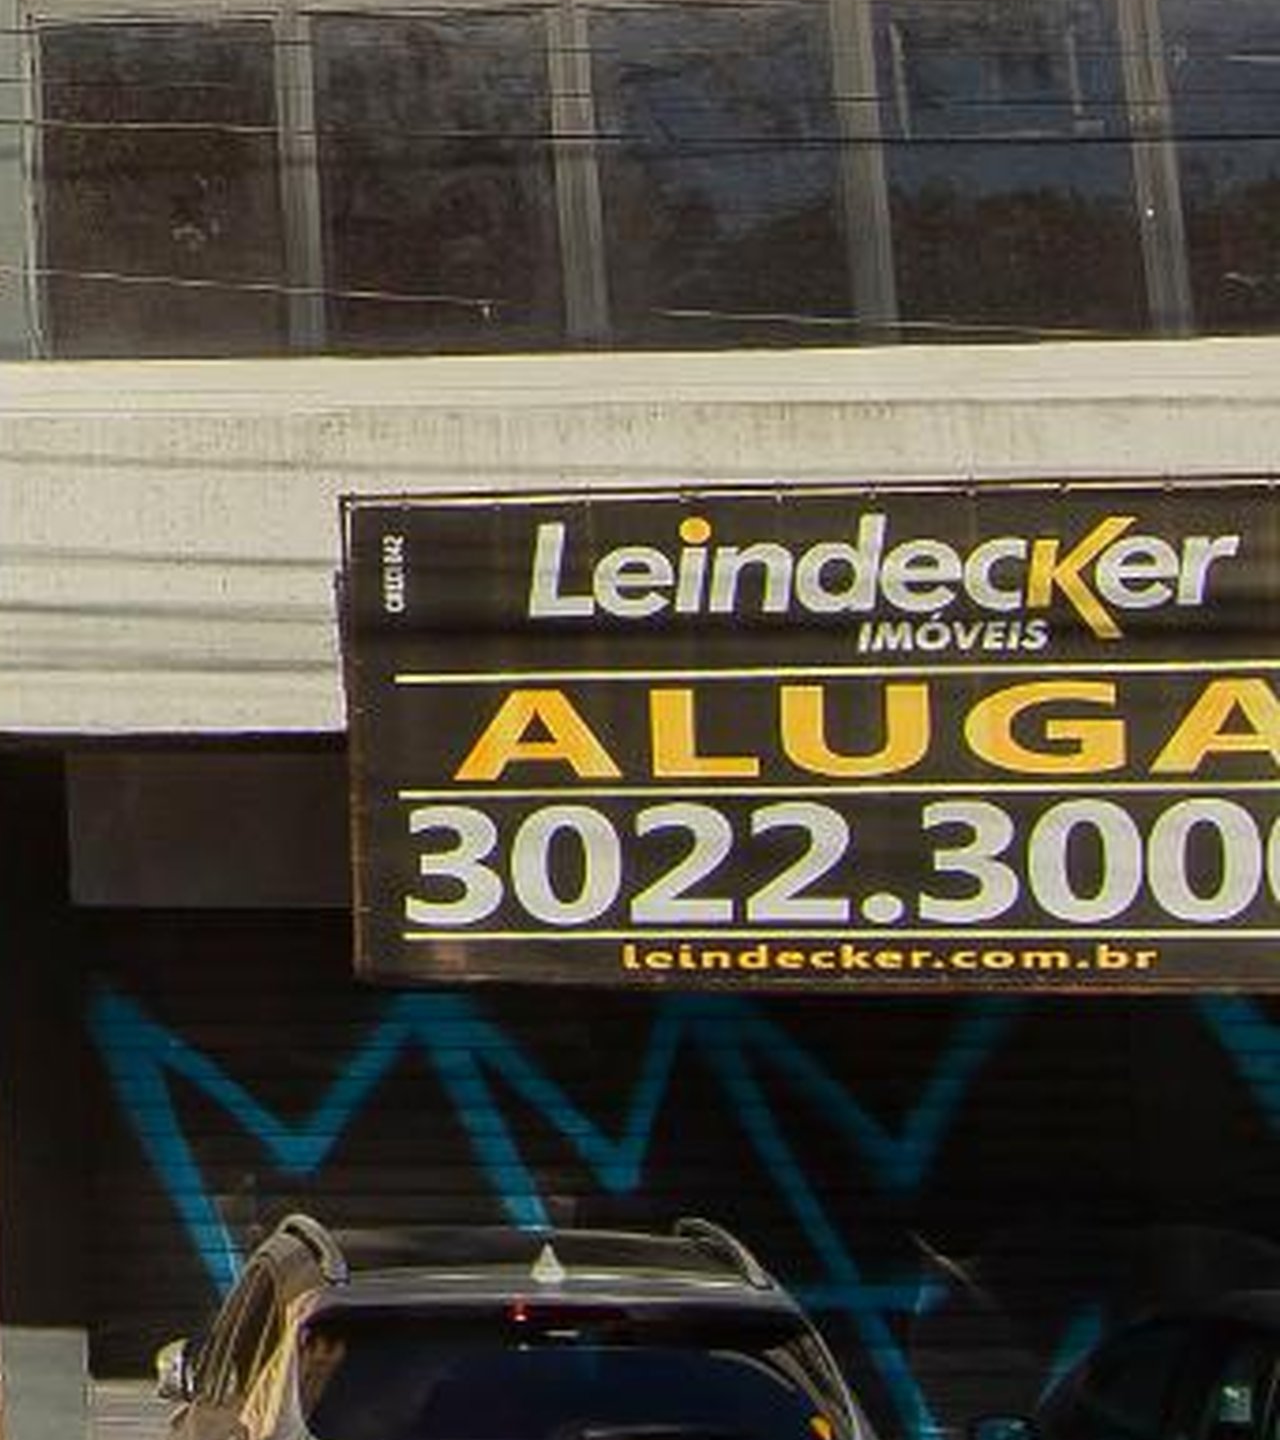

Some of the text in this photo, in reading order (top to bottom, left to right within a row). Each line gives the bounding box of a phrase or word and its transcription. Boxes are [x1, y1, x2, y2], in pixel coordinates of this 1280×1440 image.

[857, 615, 1051, 654] IMÓVEIS
[453, 677, 1280, 782] ALUGA
[404, 797, 1280, 926] 3022.300
[623, 944, 1158, 970] leindecker.com.br
